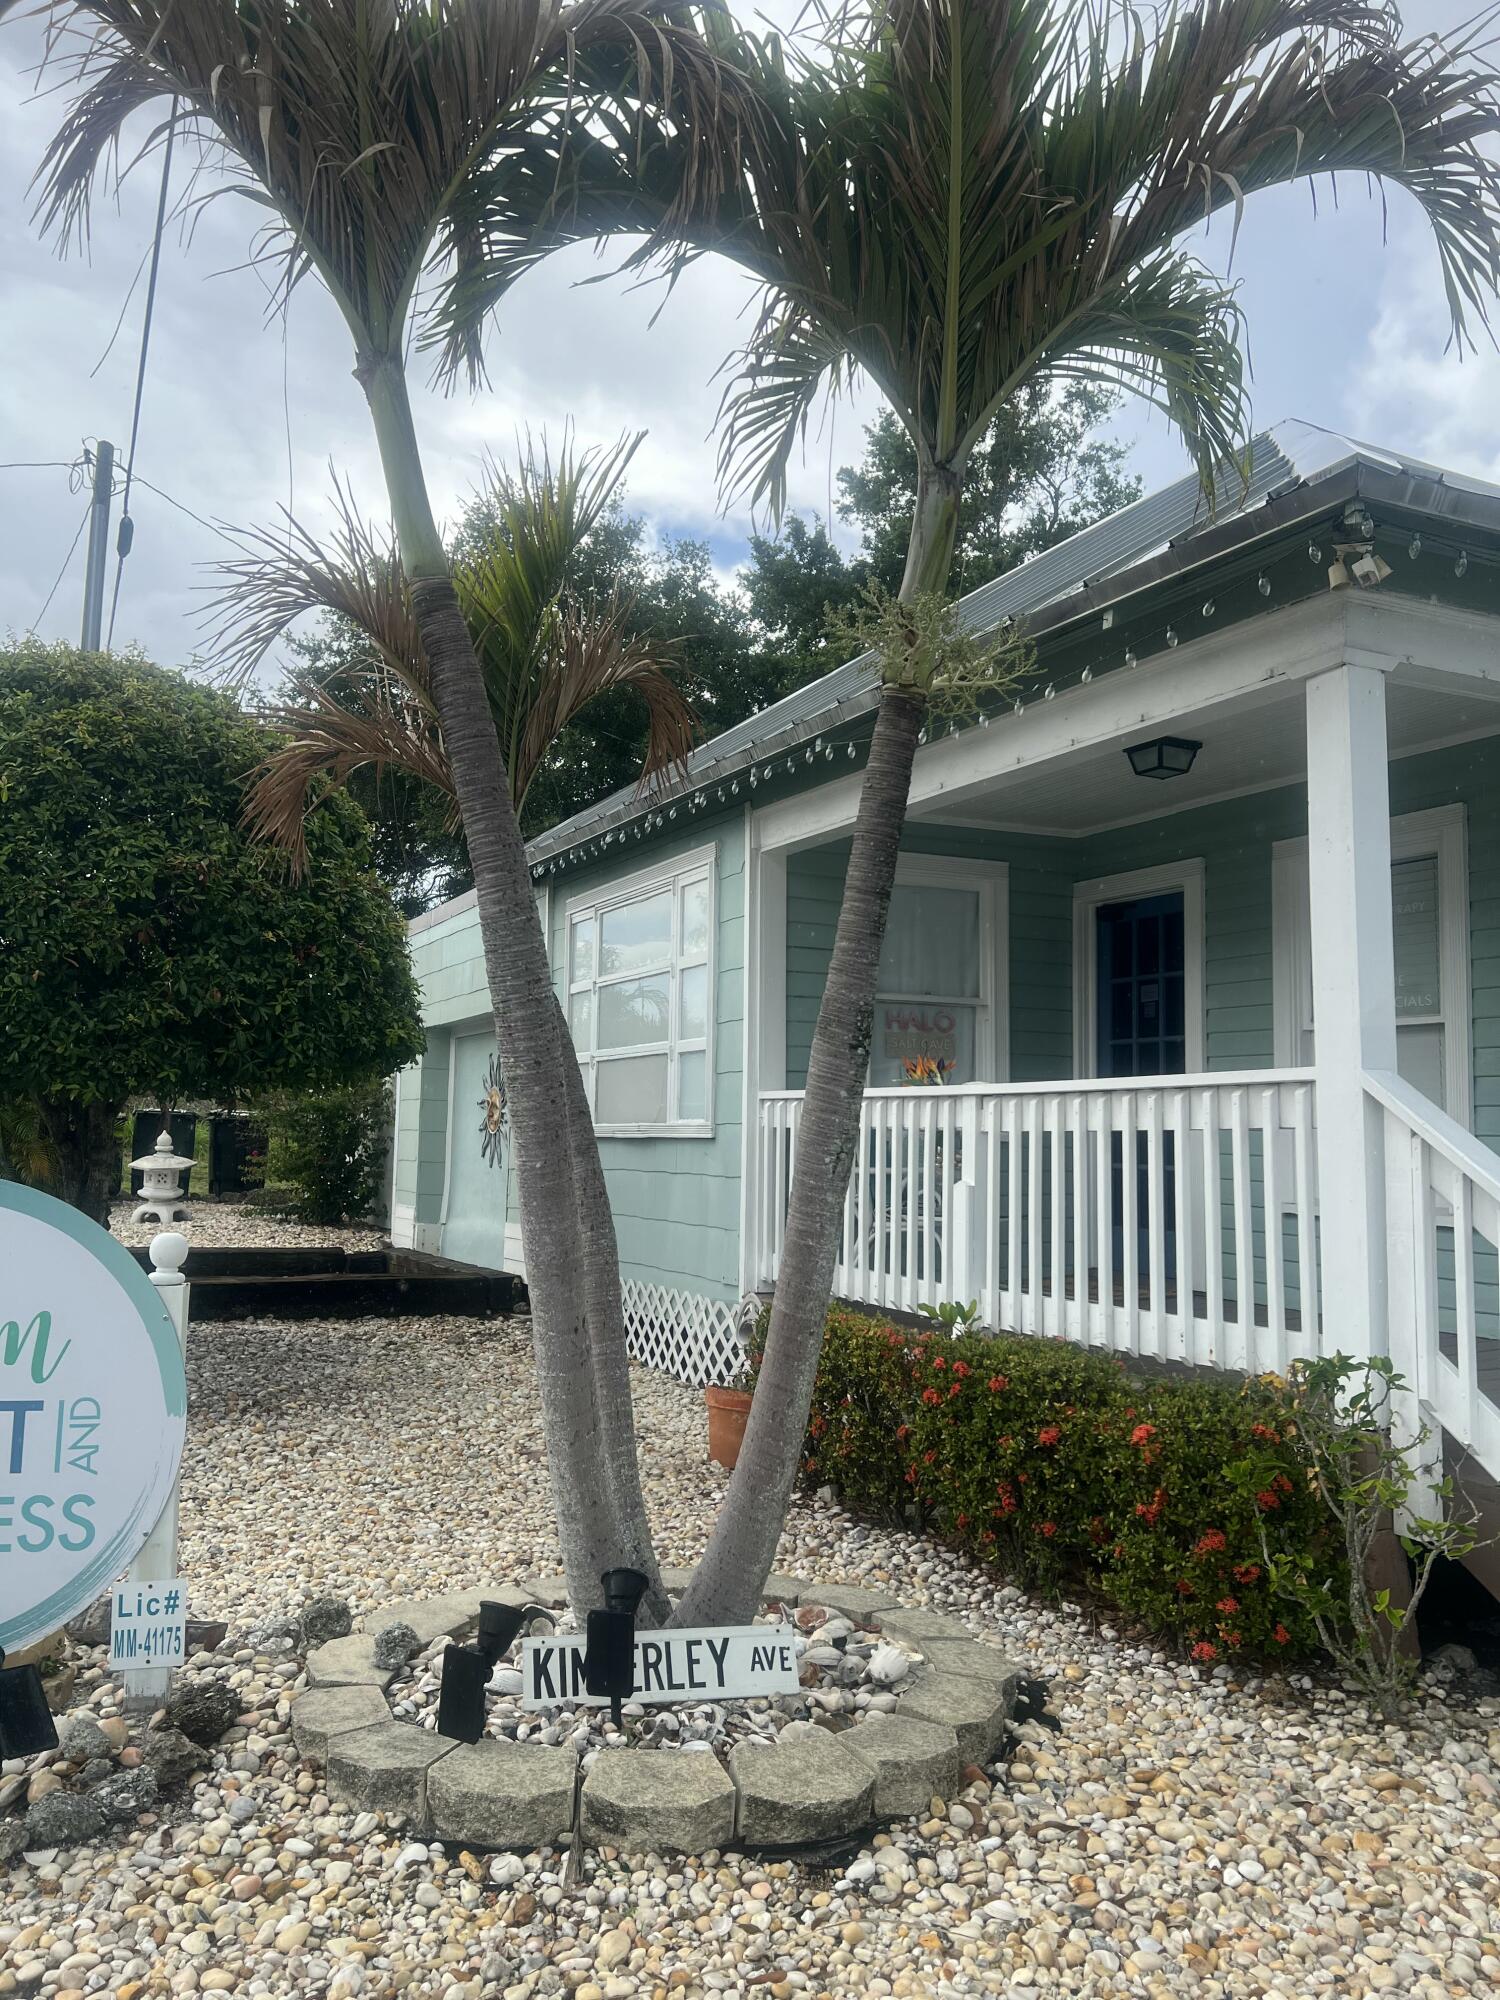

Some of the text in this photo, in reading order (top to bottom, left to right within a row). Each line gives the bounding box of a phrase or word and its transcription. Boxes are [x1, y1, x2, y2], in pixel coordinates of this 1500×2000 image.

[885, 1008, 956, 1034] HALO
[889, 1039, 951, 1050] SALT CAVE
[67, 1397, 101, 1475] AND
[118, 1590, 180, 1618] Lic#
[114, 1626, 181, 1659] MM-41175
[533, 1637, 793, 1700] KIMERLEY AVE
